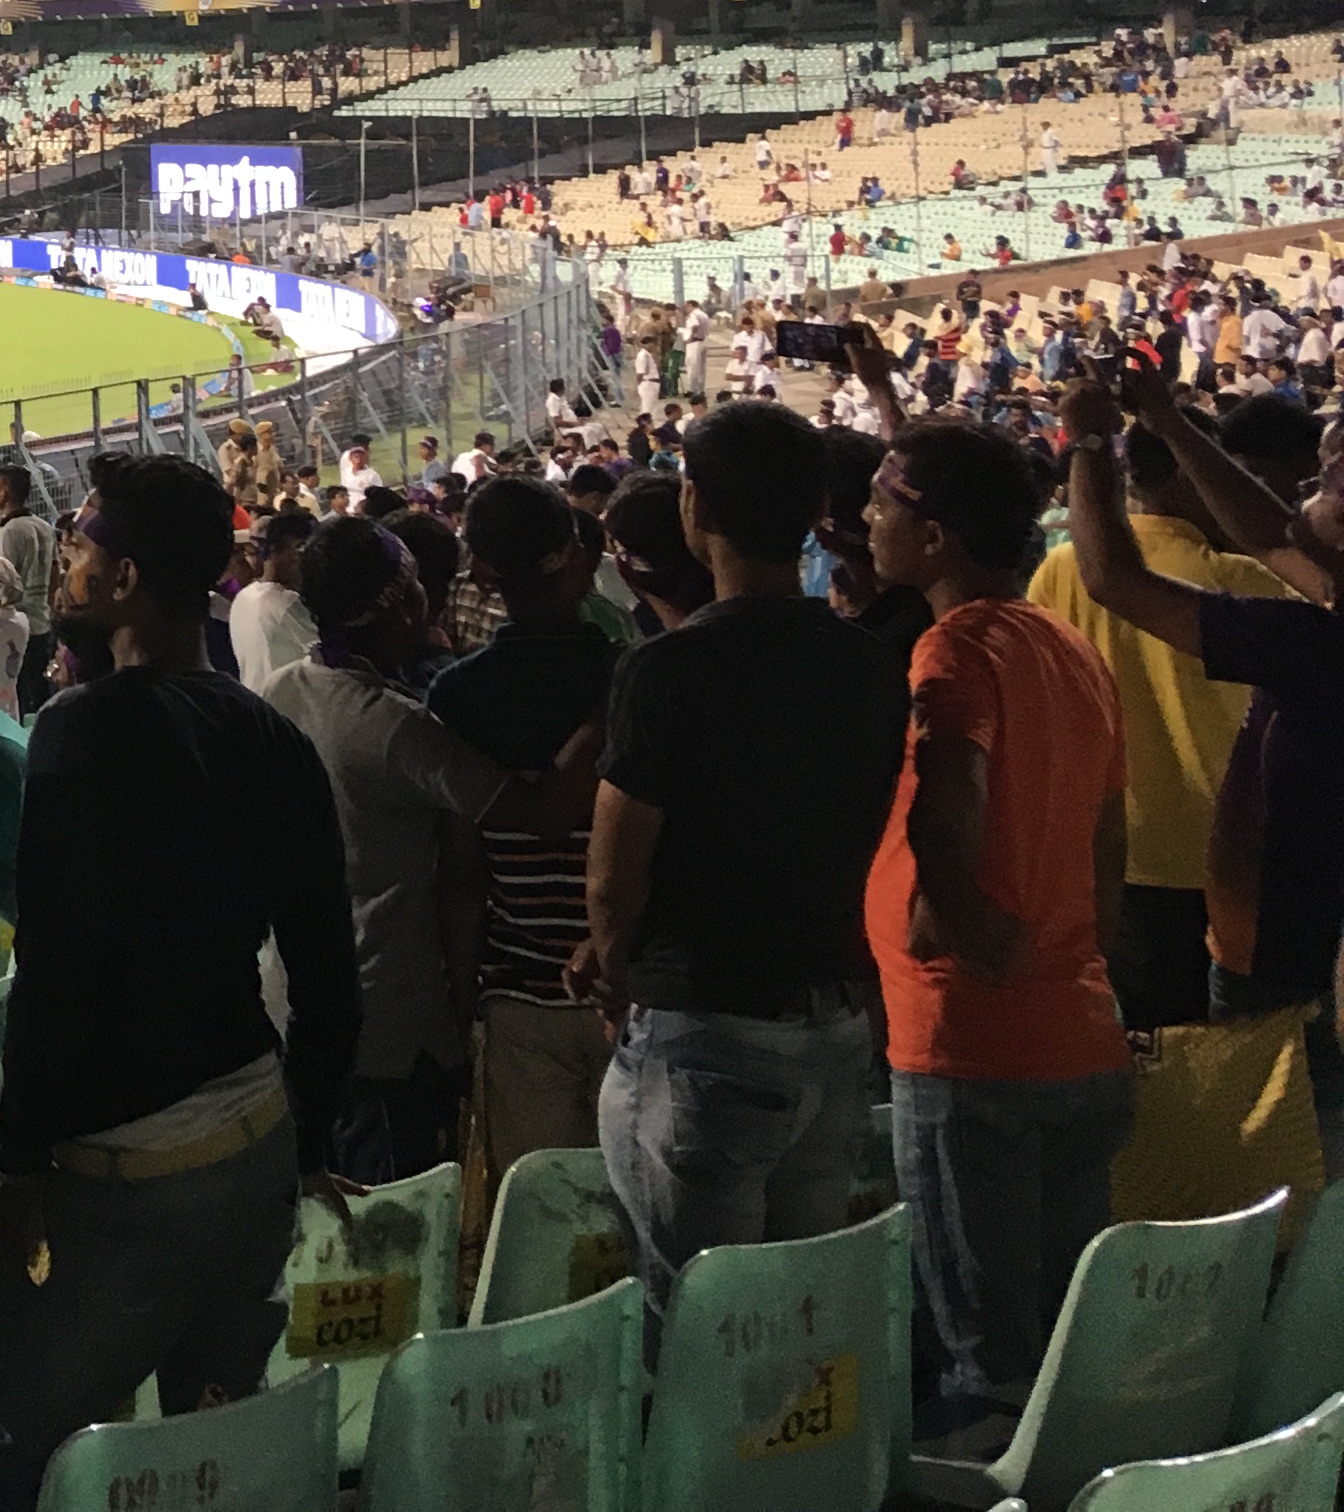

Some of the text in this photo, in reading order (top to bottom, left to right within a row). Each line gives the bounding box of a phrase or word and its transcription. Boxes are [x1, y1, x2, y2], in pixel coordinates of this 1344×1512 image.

[186, 259, 232, 299] TATA
[319, 1280, 384, 1307] LUX
[316, 1302, 382, 1347] cozi
[764, 1390, 834, 1448] ozi
